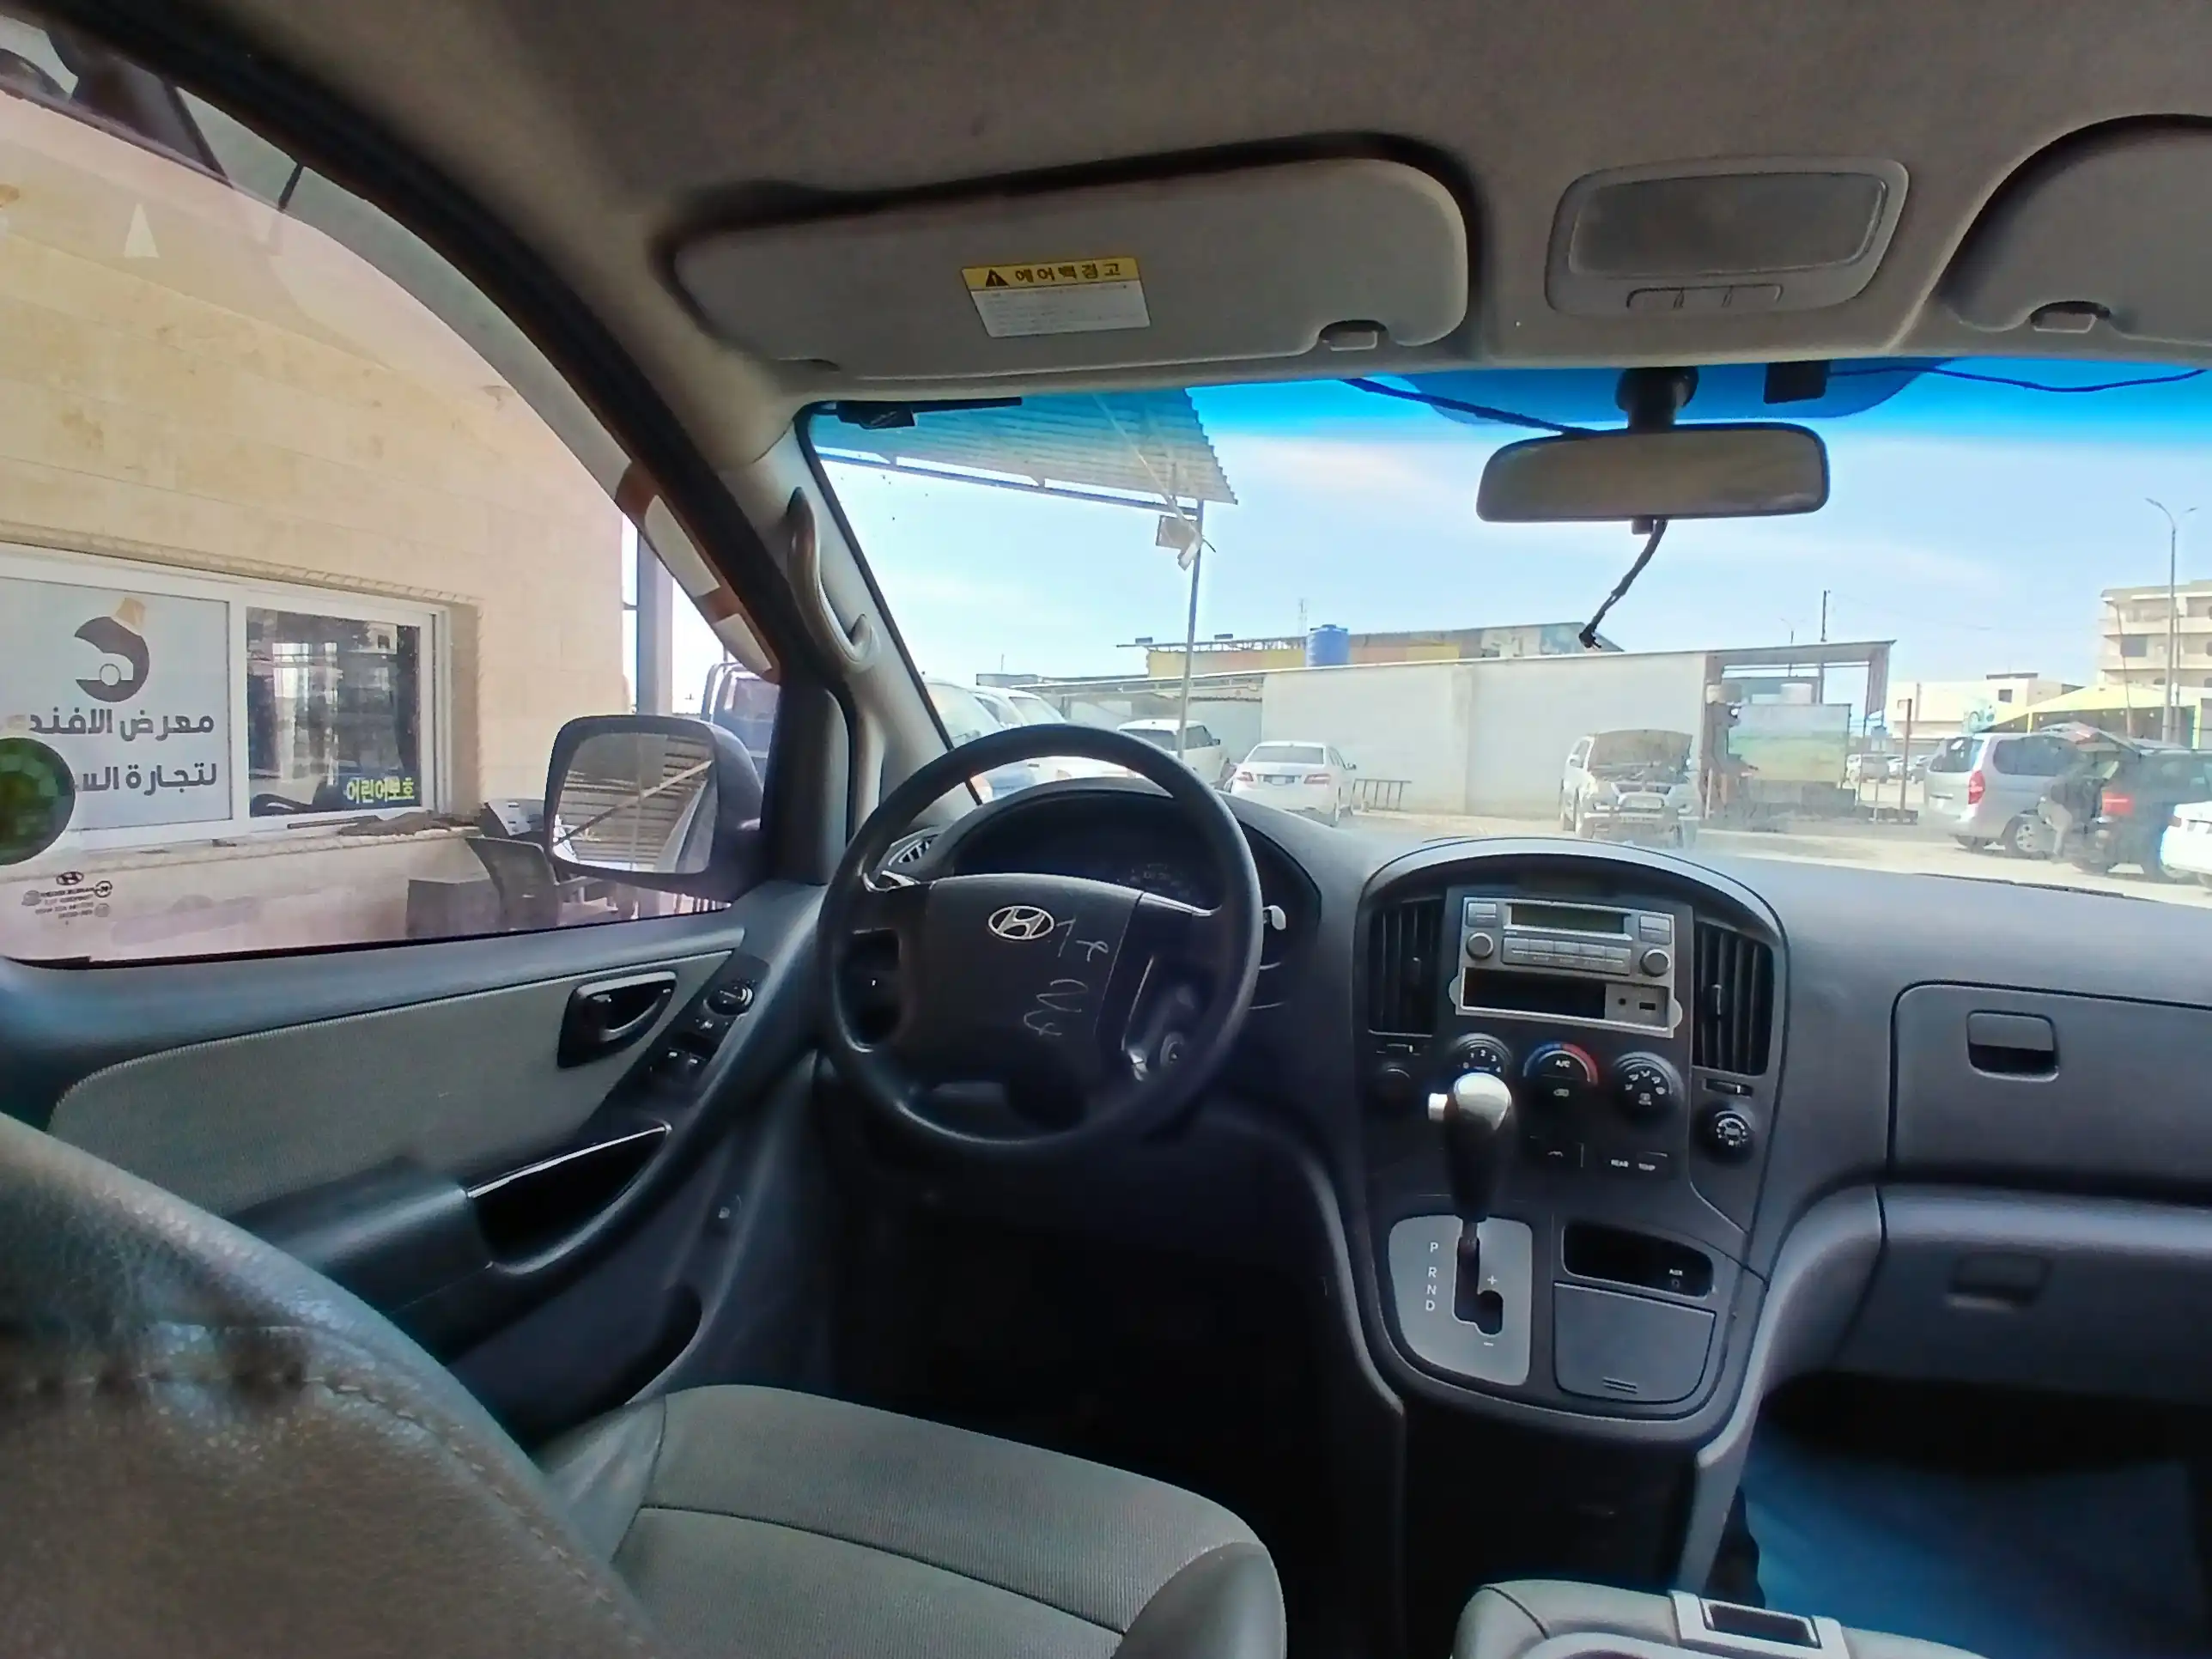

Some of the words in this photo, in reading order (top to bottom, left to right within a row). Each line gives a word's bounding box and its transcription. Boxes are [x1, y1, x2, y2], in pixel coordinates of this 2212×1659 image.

[28, 707, 112, 735] الافند
[119, 709, 215, 742] معرض
[125, 763, 217, 796] لتجارة
[1430, 1242, 1439, 1253] P
[1428, 1267, 1437, 1278] R
[1426, 1284, 1437, 1295] N
[1425, 1299, 1436, 1311] D
